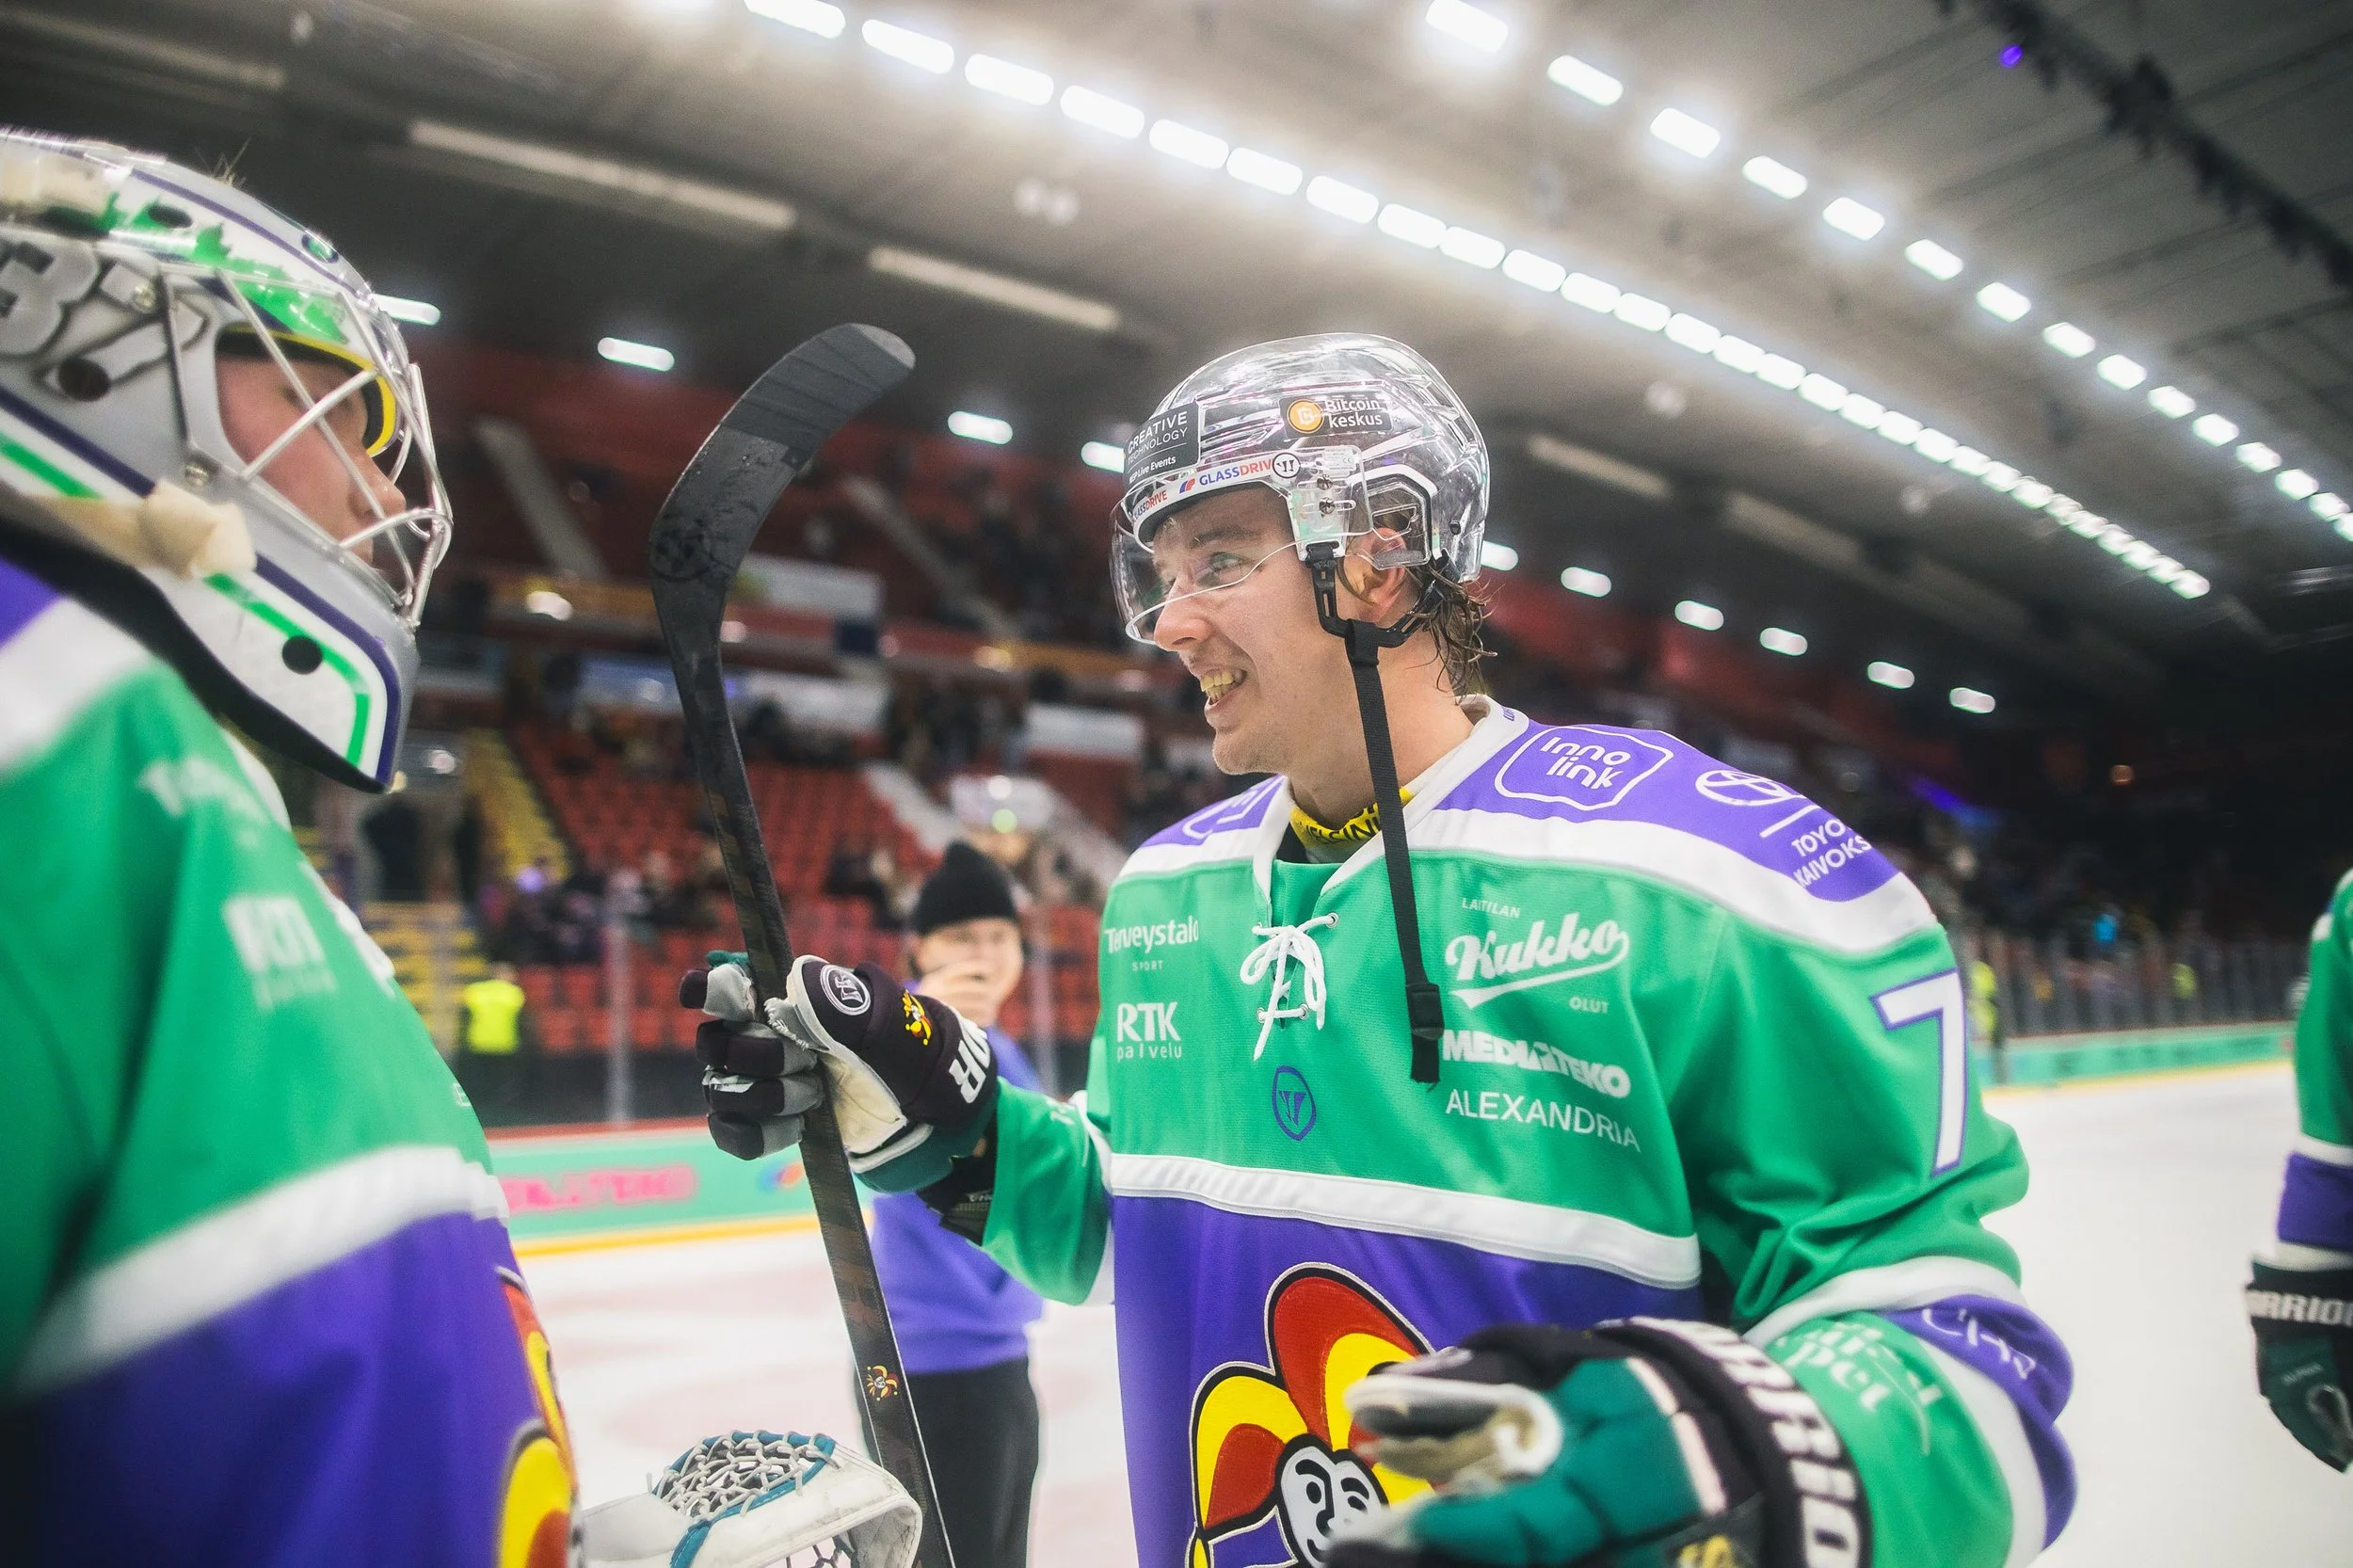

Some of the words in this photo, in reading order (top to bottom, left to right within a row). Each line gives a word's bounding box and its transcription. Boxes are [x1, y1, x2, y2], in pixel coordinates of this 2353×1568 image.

[1323, 397, 1381, 413] Bitcoin
[1328, 412, 1384, 428] keskus
[1128, 410, 1188, 455] CREATIVE
[1150, 456, 1176, 471] Events
[1199, 458, 1273, 486] GLASSDRIV
[1545, 756, 1624, 790] link
[1791, 819, 1853, 857] TOYO
[1445, 911, 1630, 982] Kukko
[1116, 1001, 1182, 1043] RTK
[1868, 967, 1969, 1177] 7
[1445, 1088, 1641, 1153] ALEXANDRIA
